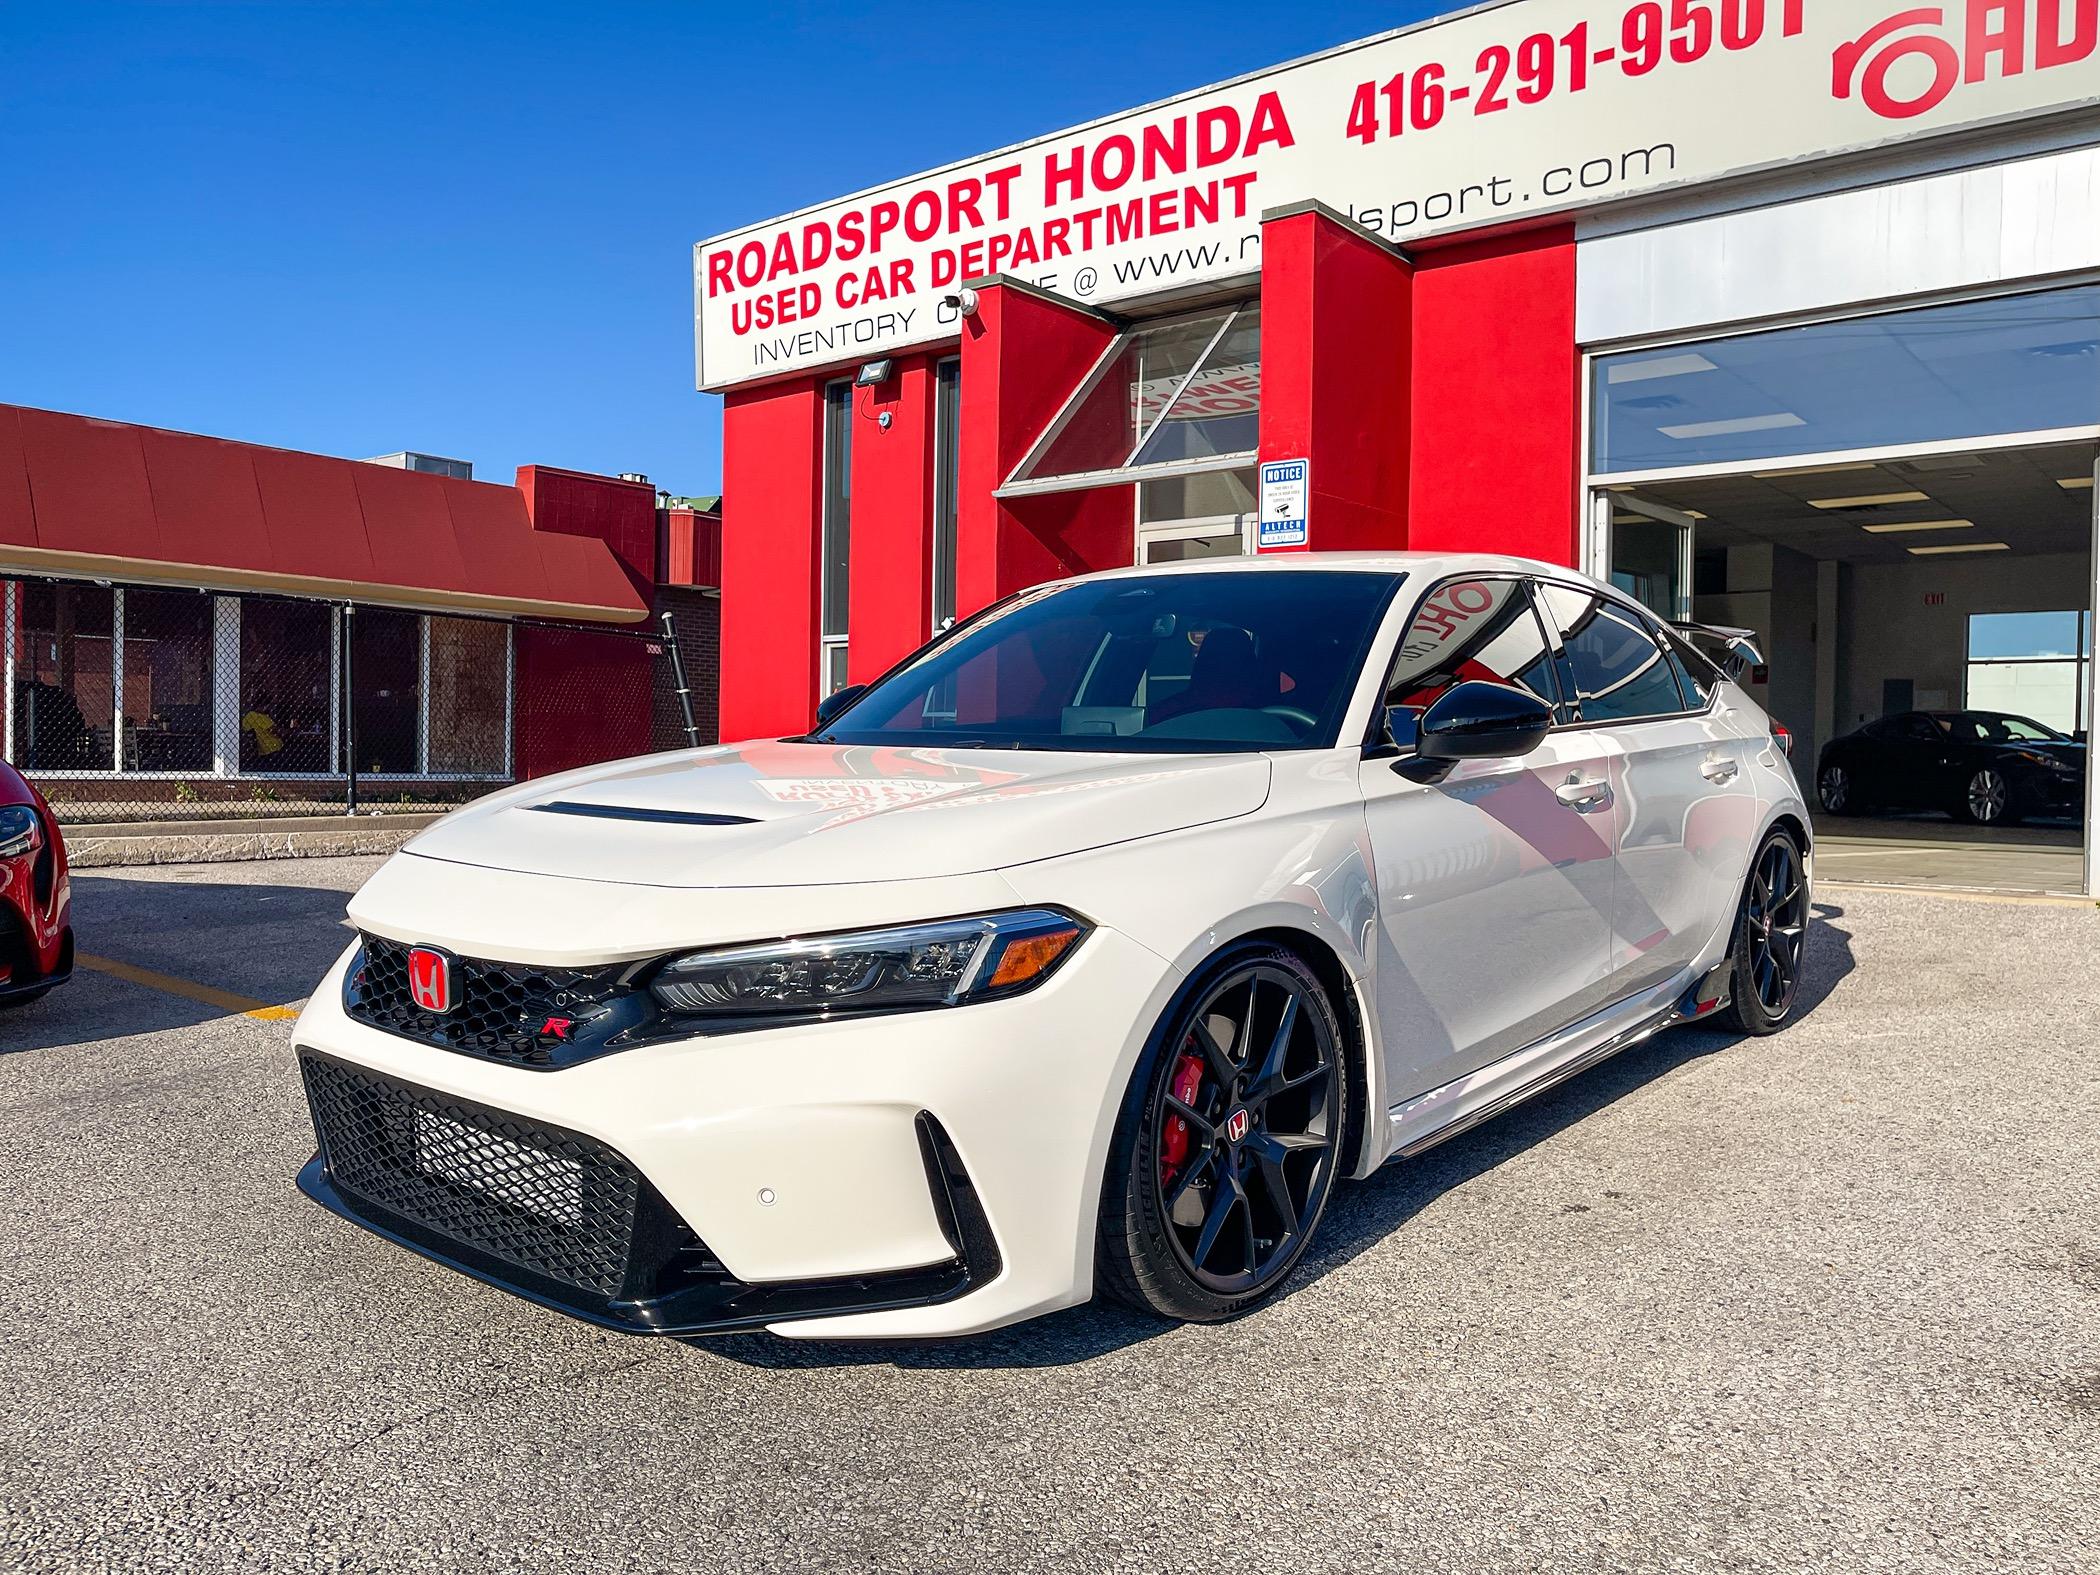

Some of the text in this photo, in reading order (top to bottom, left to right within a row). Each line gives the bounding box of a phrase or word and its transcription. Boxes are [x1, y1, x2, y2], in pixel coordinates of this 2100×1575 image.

[708, 163, 1021, 299] ROADSPORT
[1044, 90, 1296, 208] HONDA
[731, 282, 822, 336] USED
[835, 258, 916, 309] CAR
[931, 171, 1257, 289] DEPARTMENT
[754, 308, 917, 365] INVENTORY
[1266, 467, 1301, 482] NOTICE
[1264, 520, 1301, 532] ALTECH
